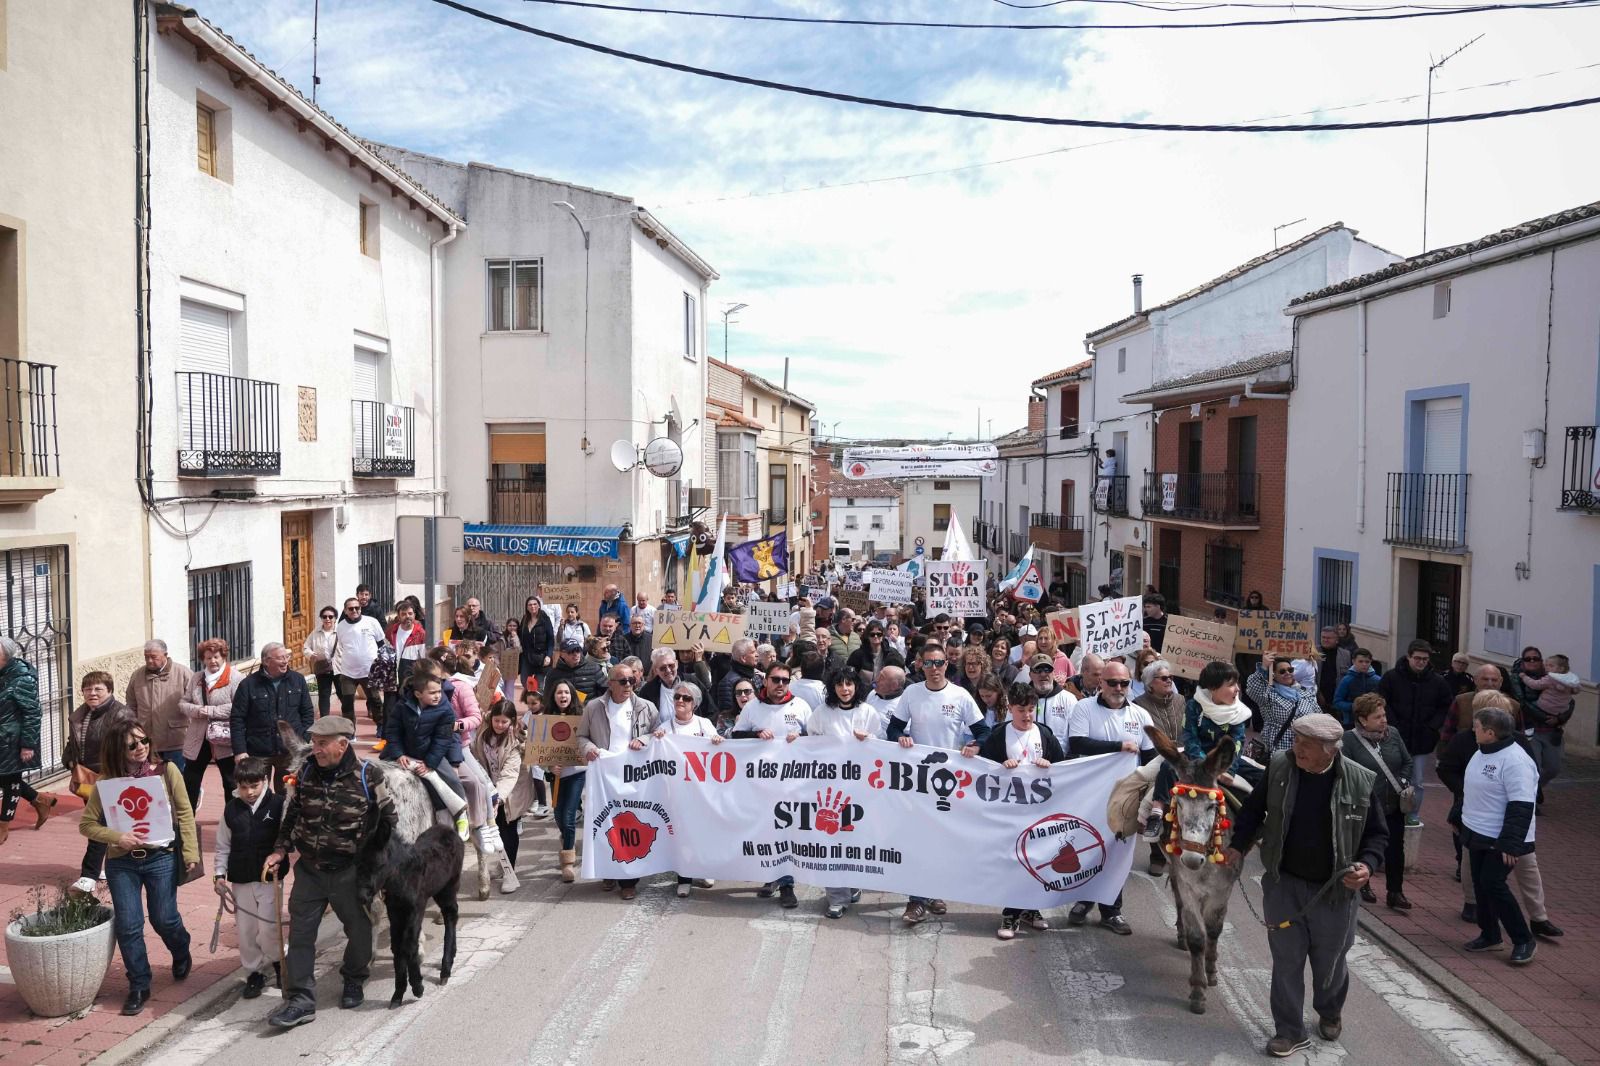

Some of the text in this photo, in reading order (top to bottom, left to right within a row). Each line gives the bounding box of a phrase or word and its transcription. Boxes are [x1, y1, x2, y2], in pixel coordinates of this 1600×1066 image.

[464, 536, 611, 554] BAR LOS MELLIZOS
[929, 571, 979, 587] STOP
[929, 587, 980, 598] PLANTA
[708, 613, 742, 625] VETE
[682, 622, 711, 640] YA
[758, 624, 787, 633] BIOGAS
[1052, 616, 1080, 641] N
[1086, 619, 1142, 643] PLANTA
[1167, 624, 1225, 643] CONSEJERA
[1239, 628, 1258, 638] NOS
[1166, 644, 1183, 656] NO
[1248, 638, 1263, 650] LA
[623, 758, 677, 784] Decimos
[683, 751, 737, 783] NO
[746, 761, 755, 779] a
[758, 759, 779, 779] las
[780, 759, 837, 782] plantas
[841, 760, 862, 781] de
[622, 799, 653, 810] Cuenca
[651, 802, 671, 824] dicen
[773, 799, 865, 833] STOP
[619, 828, 641, 848] NO
[1029, 819, 1081, 840] A la mierda
[742, 840, 755, 857] Ni
[756, 843, 773, 856] en
[773, 839, 789, 855] tu
[830, 842, 842, 859] ni
[845, 845, 861, 860] en
[864, 844, 876, 862] el
[828, 863, 864, 873] COMUNIDAD
[1062, 875, 1073, 887] tu
[1073, 863, 1103, 882] mierda
